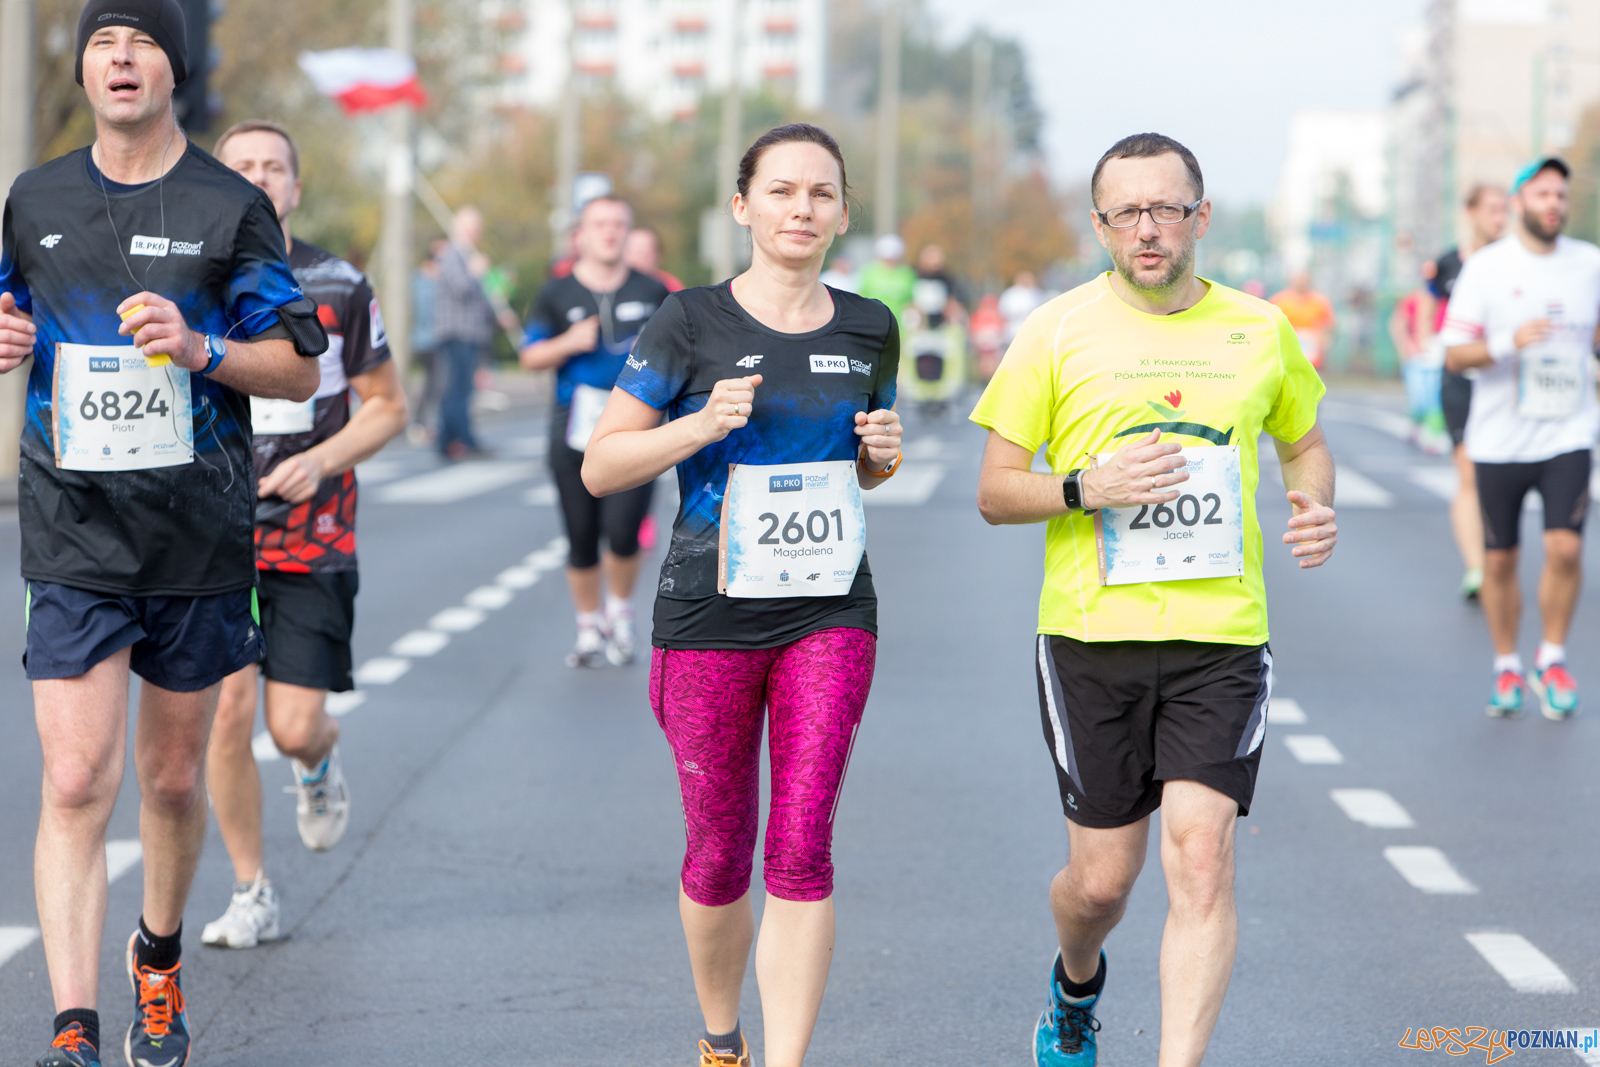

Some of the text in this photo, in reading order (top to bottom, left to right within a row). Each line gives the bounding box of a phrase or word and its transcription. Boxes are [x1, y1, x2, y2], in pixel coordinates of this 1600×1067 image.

[40, 234, 62, 248] 4F
[135, 241, 165, 250] 18. PKO
[170, 248, 201, 256] maraton
[91, 360, 118, 369] 18. PKO
[736, 355, 763, 368] 4F
[814, 360, 846, 368] 18. PKO
[851, 366, 871, 377] maraton
[79, 388, 169, 421] 6824
[112, 423, 136, 433] Piotr
[772, 478, 801, 488] 18. PKO
[805, 480, 829, 488] maraton
[1129, 492, 1223, 530] 2602
[758, 508, 843, 545] 2601
[1162, 530, 1195, 540] Jacek
[773, 546, 833, 559] Magdalena
[1182, 555, 1196, 563] 4F
[806, 573, 821, 581] 4F
